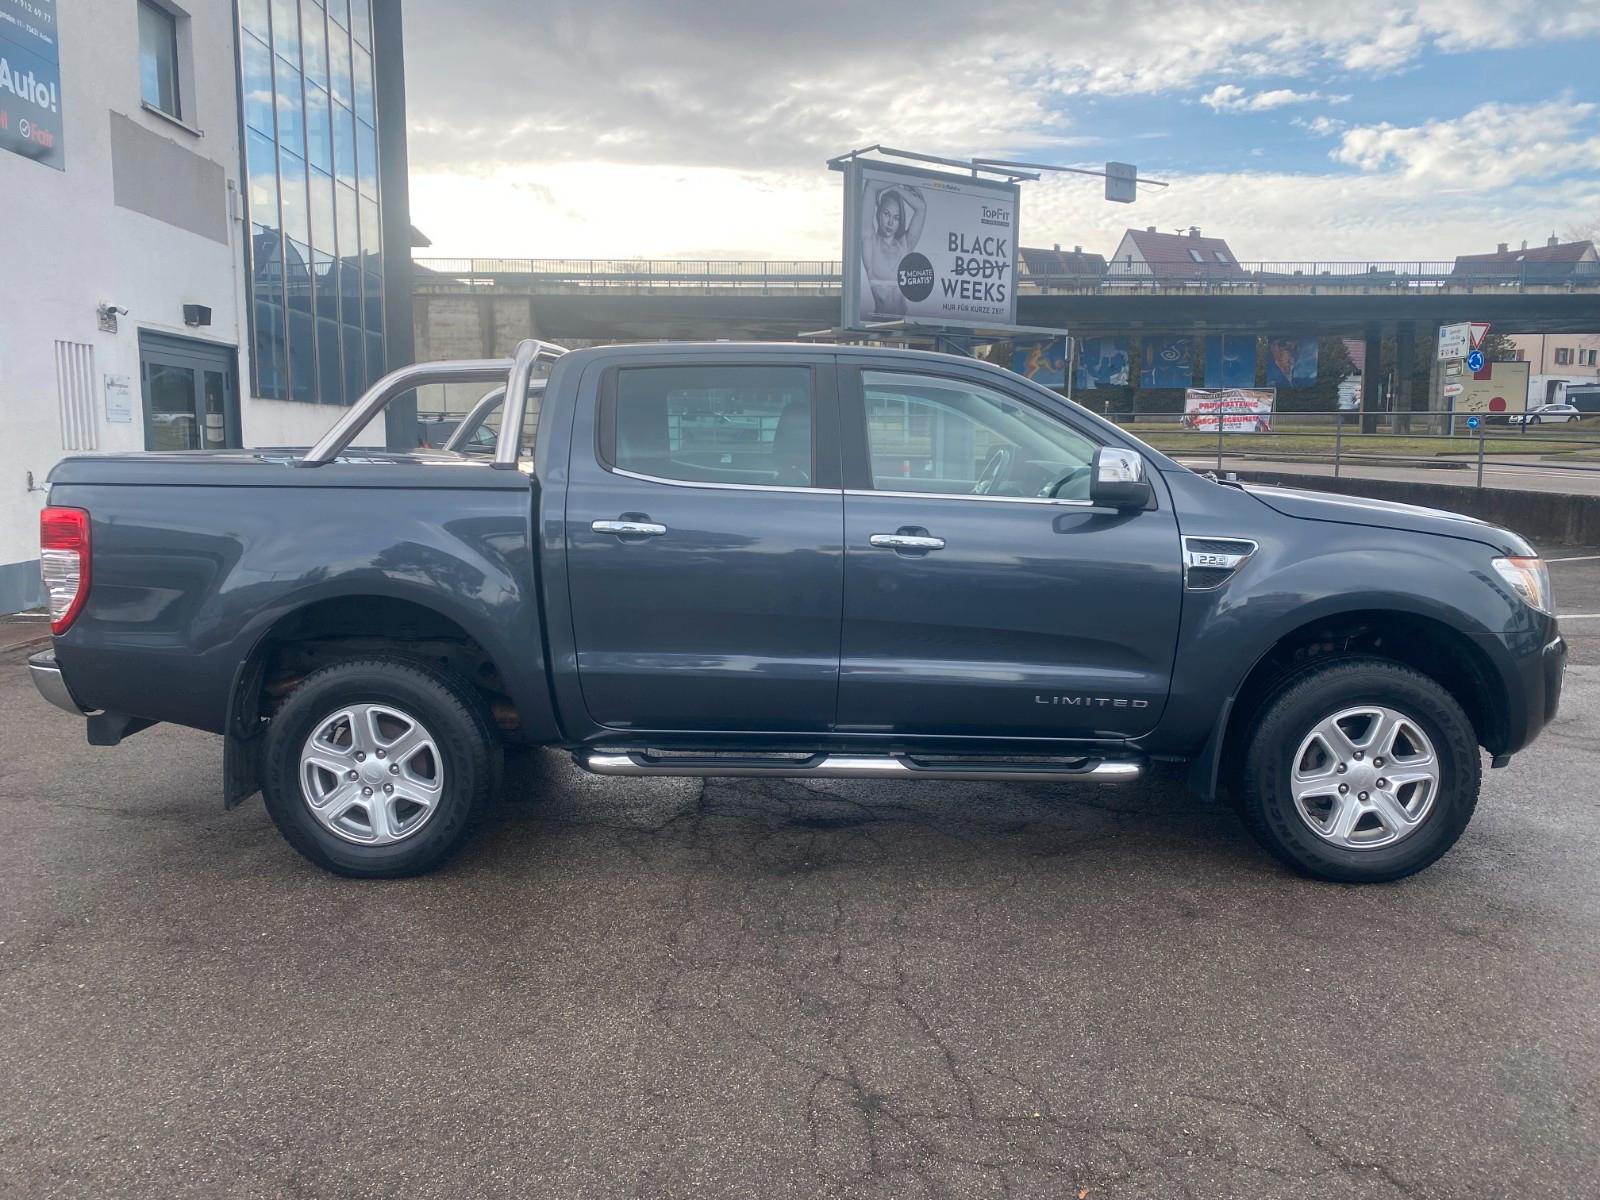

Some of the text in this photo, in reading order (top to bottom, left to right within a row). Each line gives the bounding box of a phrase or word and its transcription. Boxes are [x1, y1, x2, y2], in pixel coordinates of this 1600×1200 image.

[0, 57, 57, 113] Auto!
[948, 232, 1007, 259] BLACK
[899, 270, 907, 286] 3
[955, 256, 1007, 281] BODY
[941, 278, 1006, 303] WEEKS
[1035, 695, 1148, 708] LIMITED
